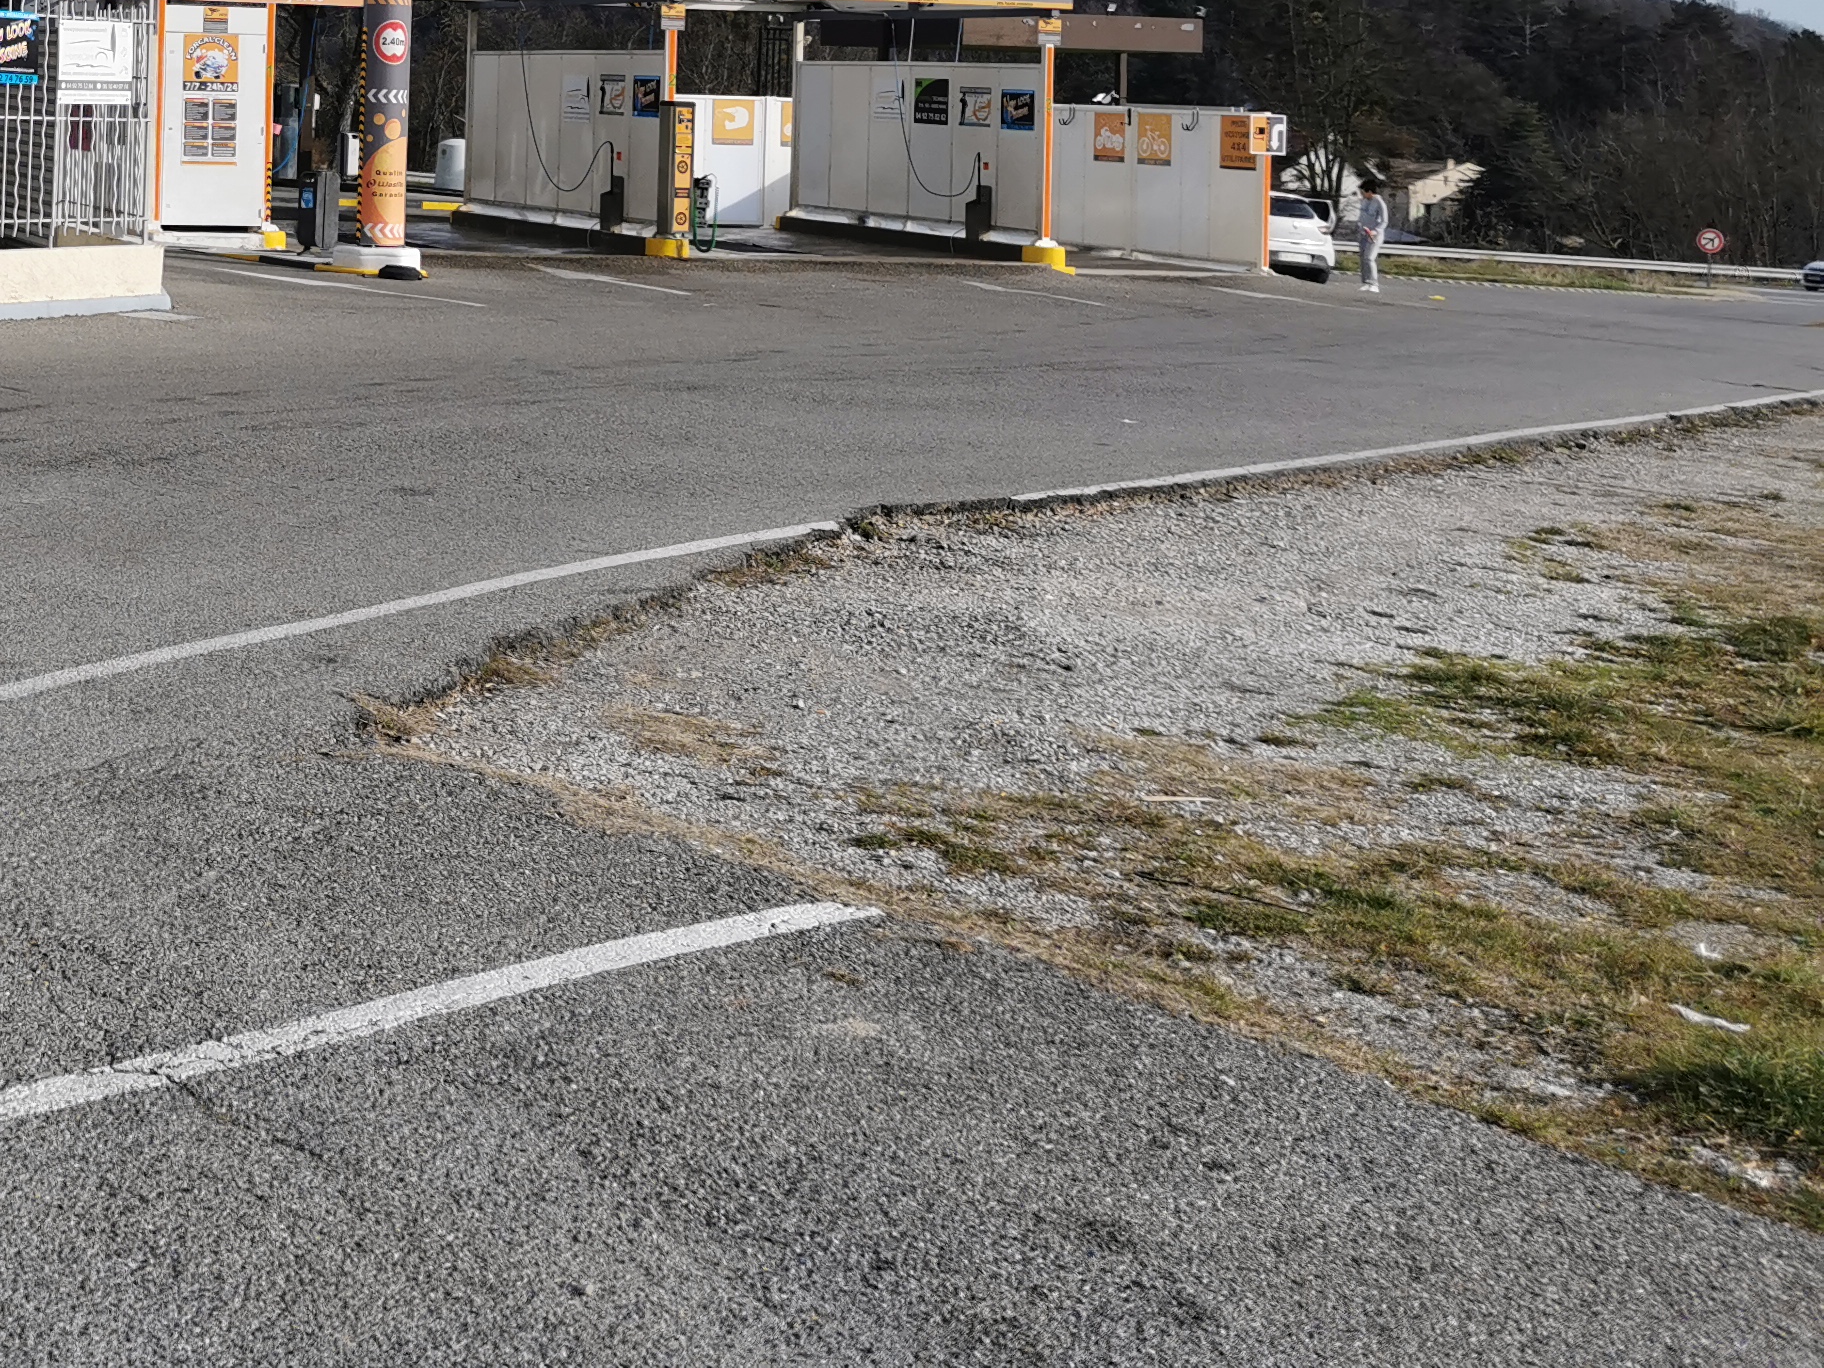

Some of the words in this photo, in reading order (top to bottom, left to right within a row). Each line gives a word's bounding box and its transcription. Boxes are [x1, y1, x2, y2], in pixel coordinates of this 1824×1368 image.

[381, 36, 405, 46] 2.40m
[184, 82, 200, 91] 7/7
[206, 83, 238, 92] 24h/24
